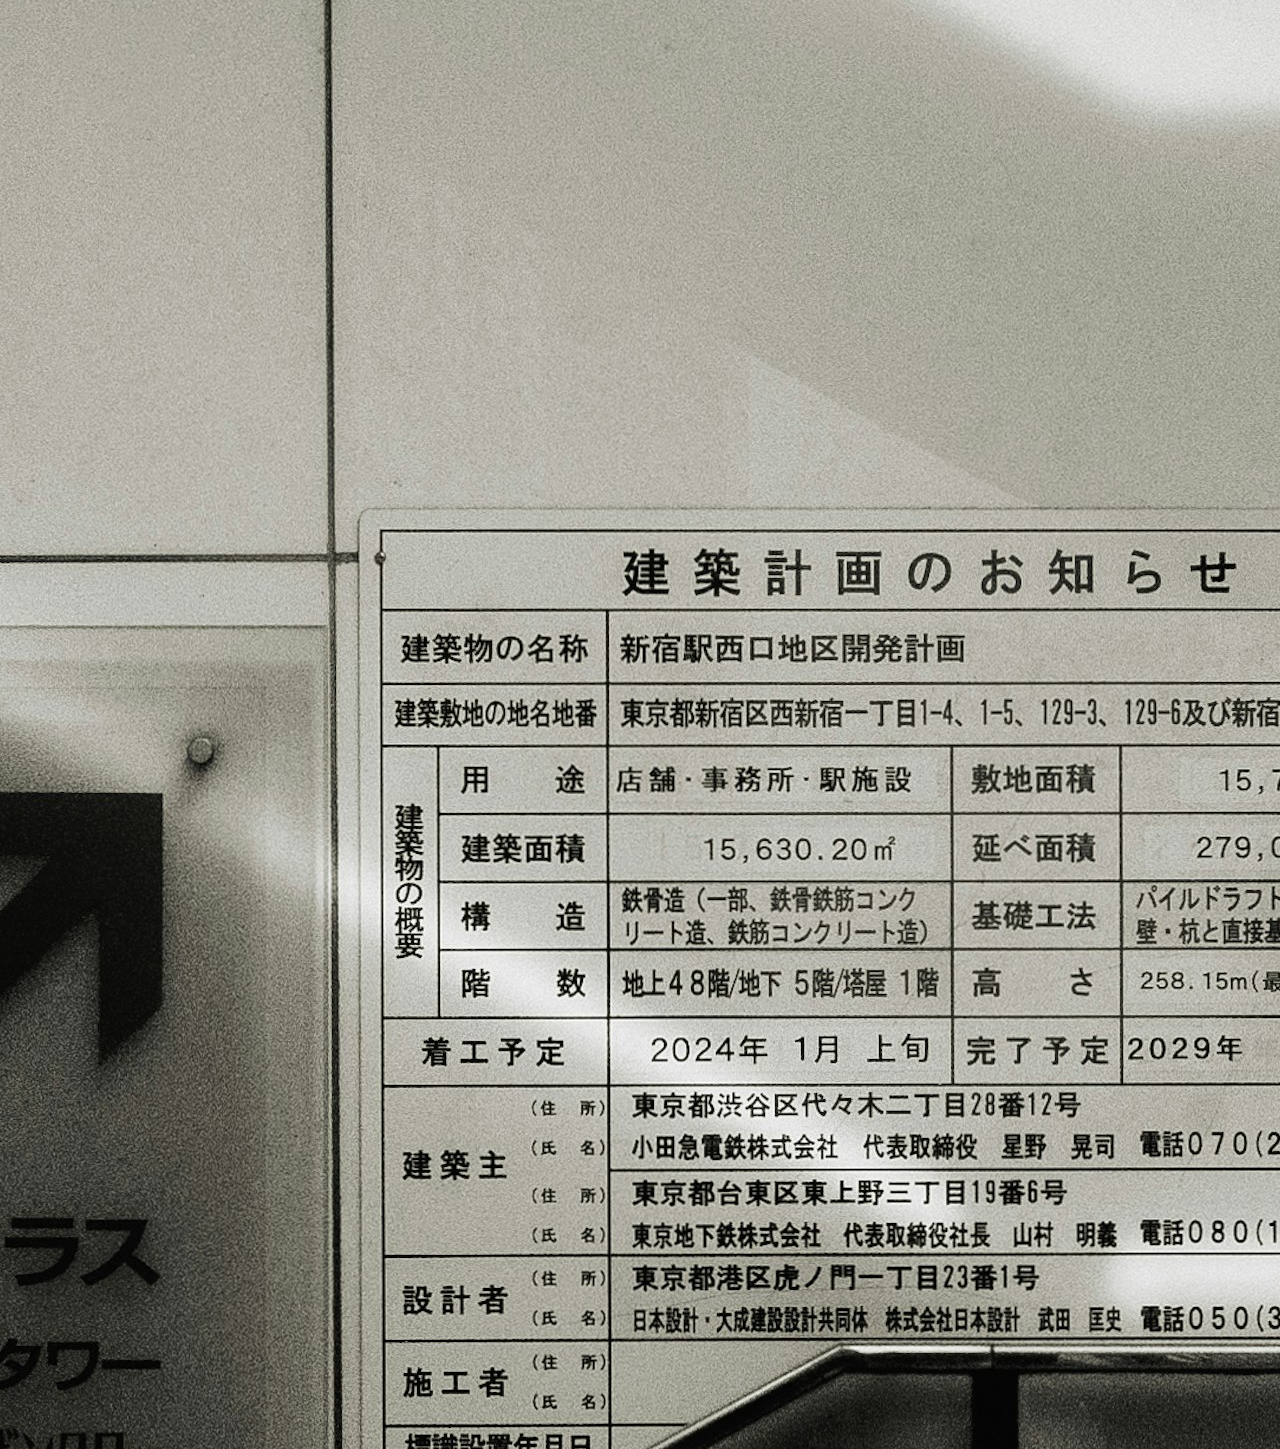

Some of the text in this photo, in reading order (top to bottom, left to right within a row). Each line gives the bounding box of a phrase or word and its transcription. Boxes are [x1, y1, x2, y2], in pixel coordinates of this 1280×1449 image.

[622, 547, 1237, 598] 建築計画のお知らせ
[400, 632, 589, 665] 建築物の名称
[619, 632, 966, 664] 新宿駅西口地区開発計画
[394, 697, 598, 729] 建築敷地の地名地番
[616, 765, 912, 793] 店舗・事務所・駅施設
[971, 763, 1096, 795] 敷地面積
[461, 833, 585, 864] 建築面積
[972, 832, 1096, 863] 延べ面積
[394, 802, 424, 960] 建築物の概要
[621, 885, 915, 914] 鉄骨造（一部、鉄骨鉄筋コンク
[971, 900, 1097, 931] 基礎工法
[625, 917, 928, 946] リート造、鉄筋コンクリート造）
[421, 1036, 565, 1067] 着工予定
[651, 1033, 929, 1065] 2024年 1月 上旬
[966, 1035, 1109, 1066] 完了予定
[1128, 1034, 1243, 1062] 2029年
[631, 1091, 1082, 1119] 東京都渋谷区代々木二丁目28番12号
[631, 1133, 838, 1161] 小田急電鉄株式会社
[863, 1132, 978, 1161] 代表取締役
[1001, 1133, 1047, 1160] 星野
[1071, 1133, 1115, 1160] 晃司
[402, 1149, 508, 1181] 建築主
[632, 1178, 1068, 1207] 東京都台東区東上野三丁目19番6号
[631, 1221, 822, 1250] 東京地下鉄株式会社
[843, 1221, 991, 1249] 代表取締役社長
[1013, 1221, 1054, 1248] 山村
[1076, 1220, 1117, 1249] 明義
[632, 1263, 1040, 1292] 東京都港区虎ノ門一丁目23番1号
[402, 1284, 509, 1316] 設計者
[633, 1305, 869, 1334] 日本設計・大成建設設計共同体
[884, 1305, 1021, 1334] 株式会社日本設計
[1037, 1306, 1071, 1333] 武田
[402, 1366, 509, 1398] 施工者
